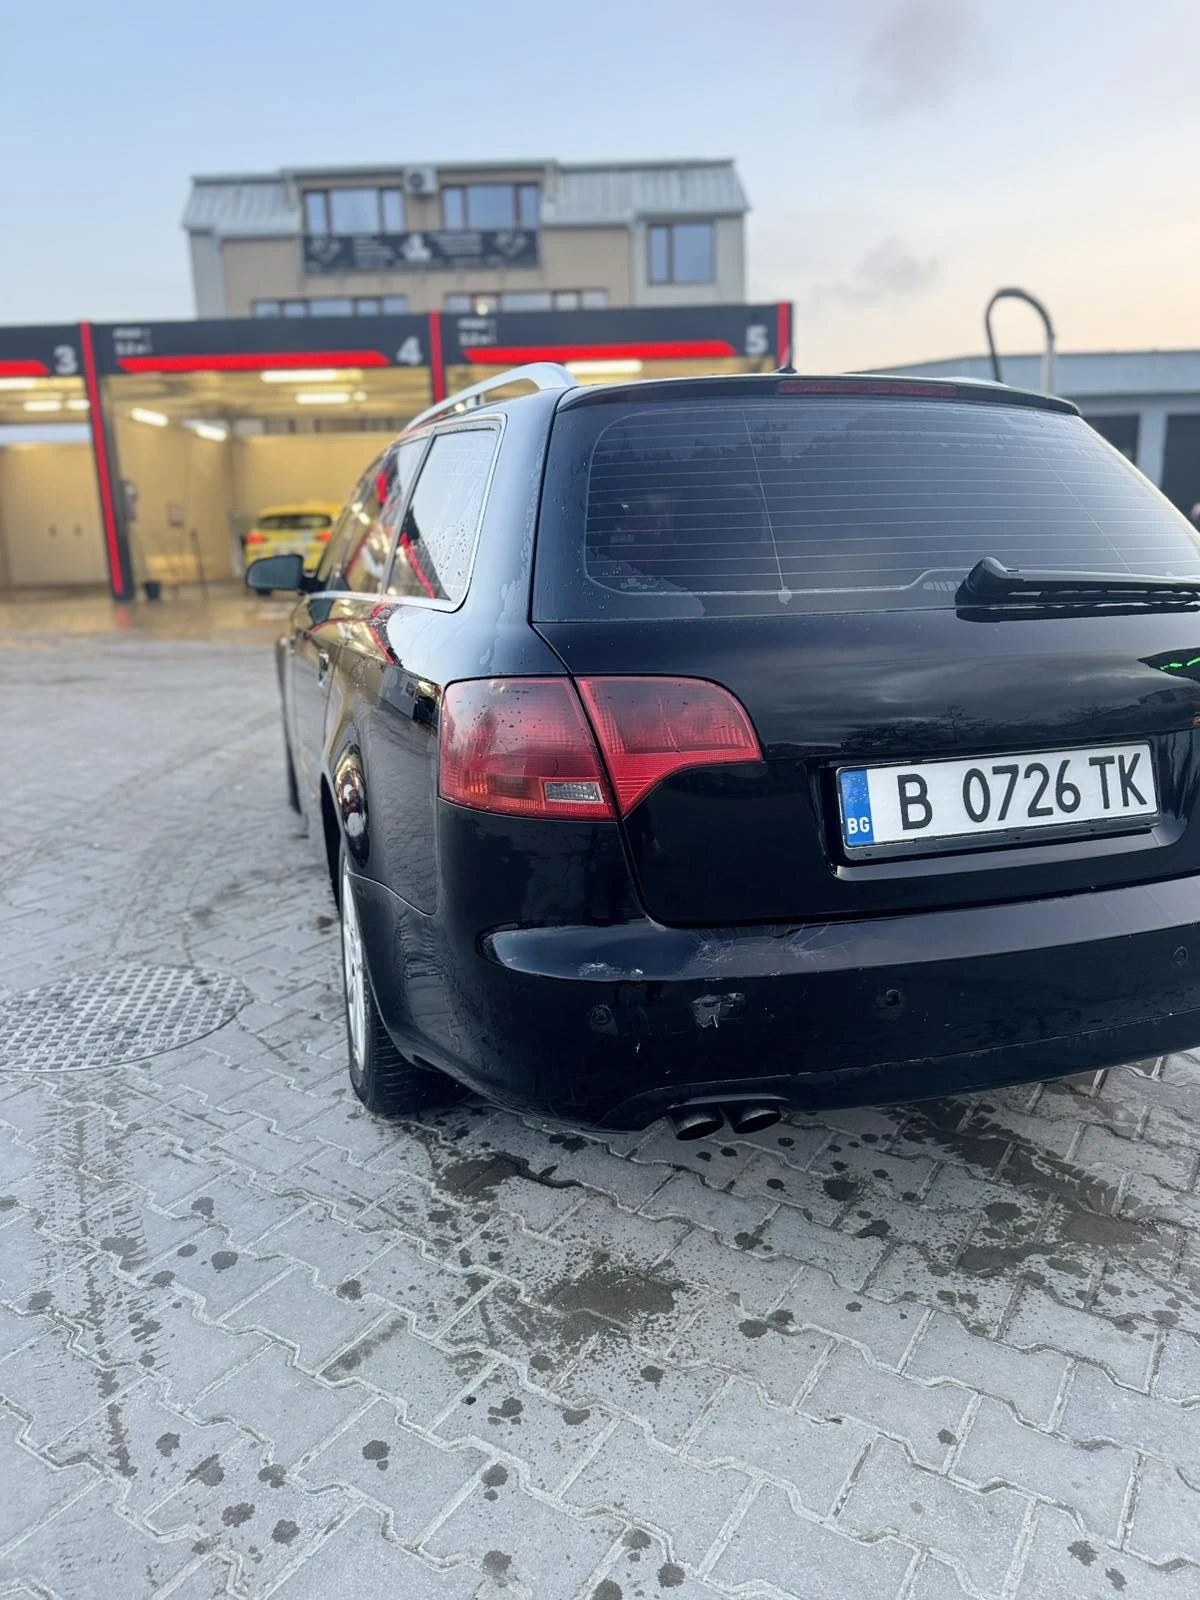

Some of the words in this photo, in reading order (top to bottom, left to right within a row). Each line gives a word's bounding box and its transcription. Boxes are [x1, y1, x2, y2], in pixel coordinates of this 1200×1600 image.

[397, 336, 422, 365] 4
[746, 326, 768, 355] 5
[54, 345, 77, 375] 3
[897, 773, 933, 830] B
[962, 759, 1081, 823] 0726
[1088, 752, 1148, 809] TK
[847, 816, 870, 834] BG
